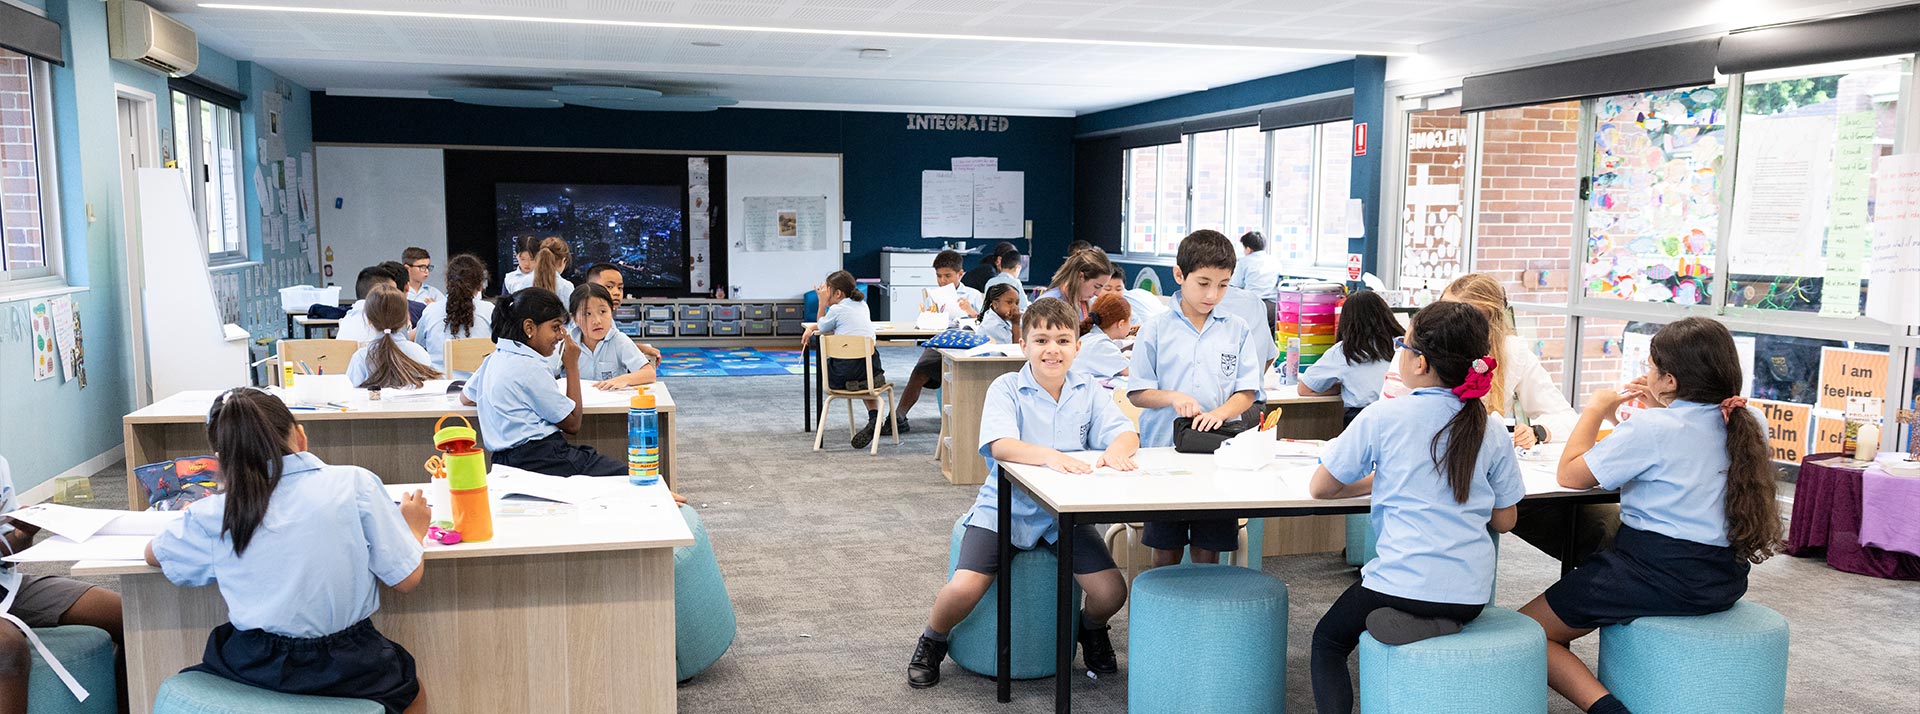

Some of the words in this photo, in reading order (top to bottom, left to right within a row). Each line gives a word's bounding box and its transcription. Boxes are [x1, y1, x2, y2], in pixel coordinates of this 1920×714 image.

[906, 114, 1009, 132] INTEGRATED
[1842, 364, 1846, 376] I
[1851, 366, 1873, 378] am
[1824, 384, 1873, 398] feeling
[1762, 404, 1793, 422] The
[1768, 424, 1797, 442] alm
[1821, 430, 1825, 442] I
[1769, 446, 1797, 461] one
